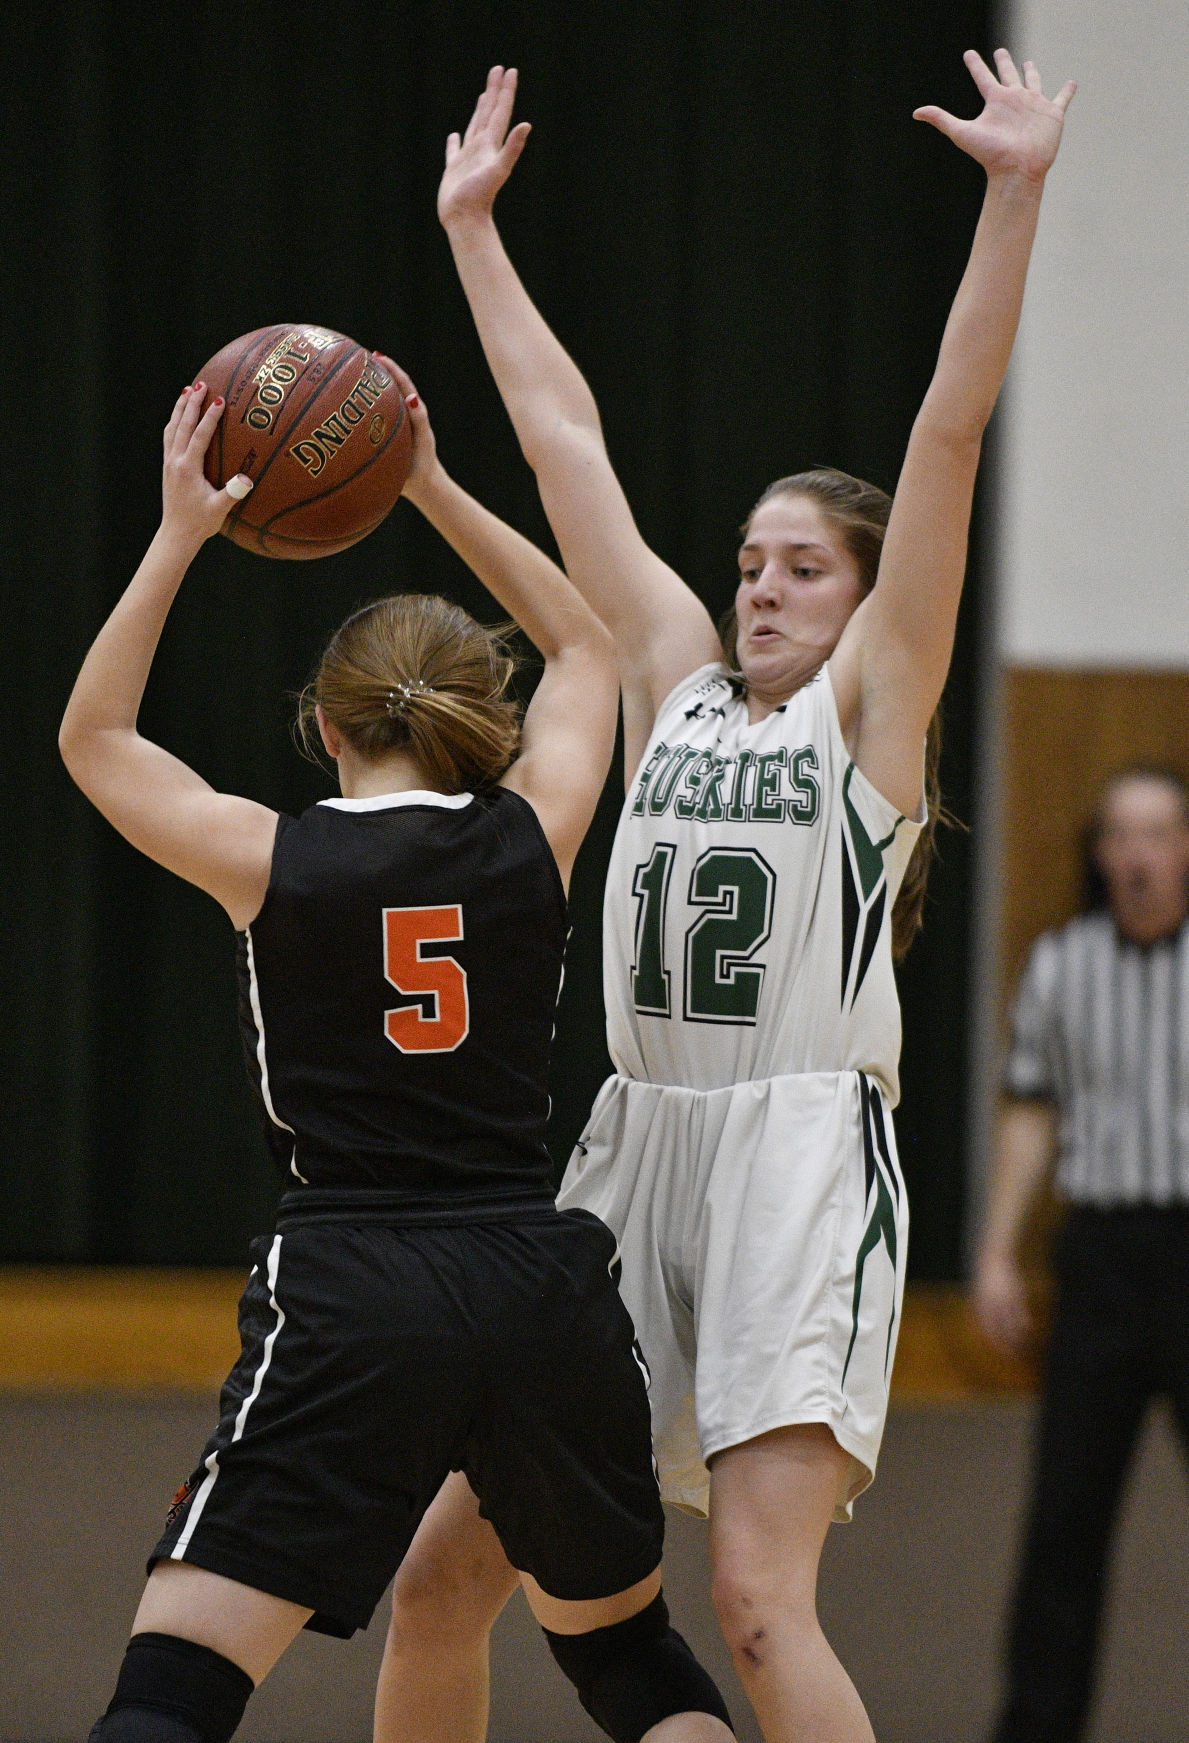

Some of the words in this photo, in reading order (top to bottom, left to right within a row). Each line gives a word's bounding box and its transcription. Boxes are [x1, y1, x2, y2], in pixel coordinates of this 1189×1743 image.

[290, 351, 393, 478] PALDING
[382, 904, 470, 1055] 5
[630, 842, 777, 1027] 12
